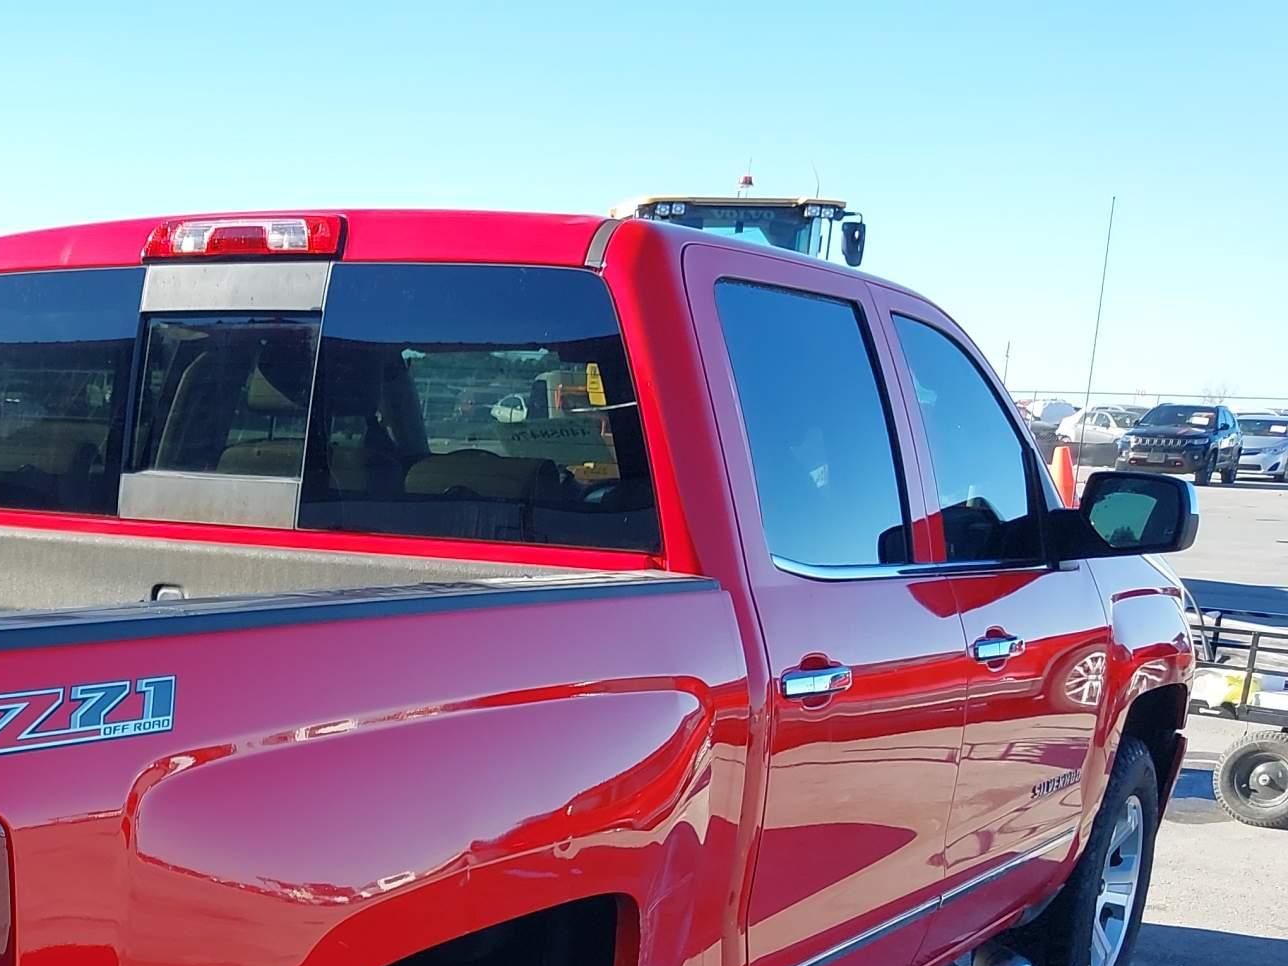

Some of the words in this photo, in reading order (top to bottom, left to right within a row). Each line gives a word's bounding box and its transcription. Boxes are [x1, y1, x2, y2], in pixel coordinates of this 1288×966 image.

[713, 208, 775, 220] VOLVO
[102, 725, 131, 738] OFF
[133, 718, 170, 732] ROAD
[1031, 768, 1082, 799] SILVERADO
